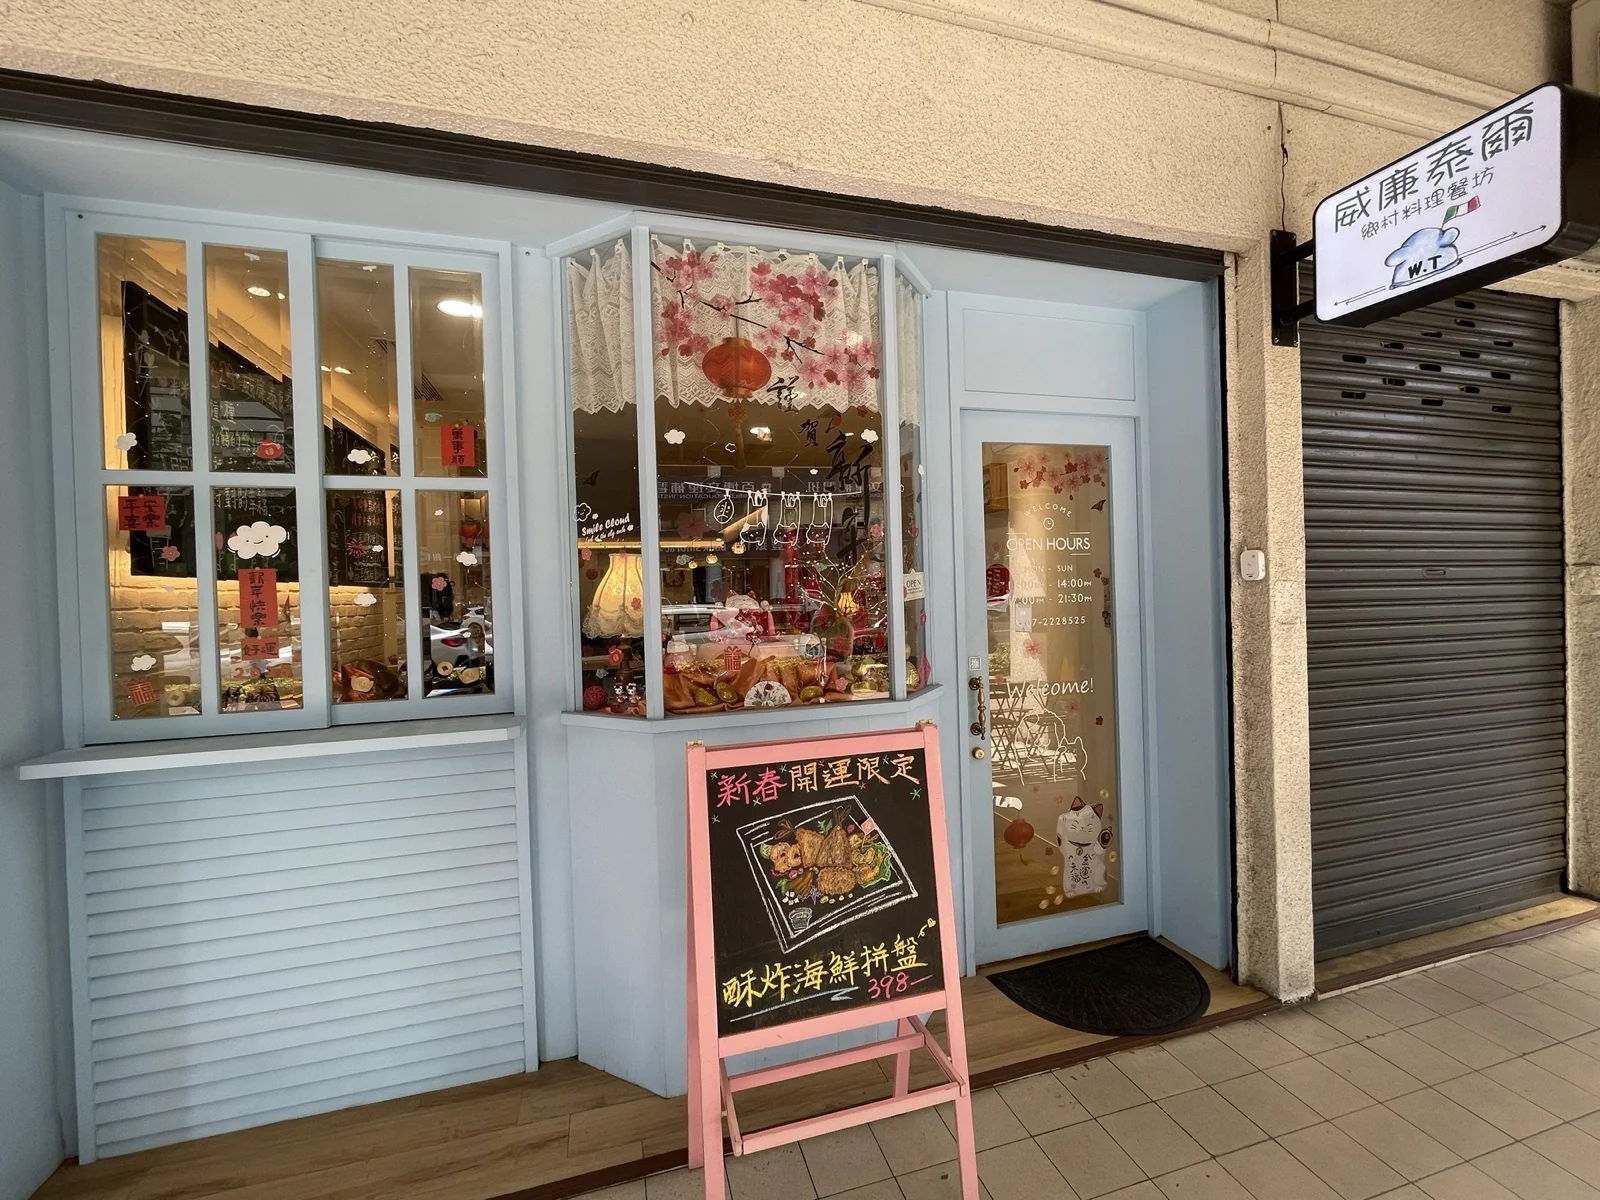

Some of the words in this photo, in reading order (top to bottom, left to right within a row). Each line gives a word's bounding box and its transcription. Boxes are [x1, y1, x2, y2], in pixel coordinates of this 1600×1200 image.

[1335, 102, 1534, 233] 威廉泰爾
[123, 499, 160, 513] 平安
[1024, 502, 1072, 518] WELCOME
[123, 515, 160, 529] 喜樂
[582, 522, 603, 536] Smile
[605, 513, 630, 529] Cloud
[1006, 537, 1043, 551] OPEN
[1046, 537, 1091, 551] HOURS
[1056, 564, 1073, 573] SUN
[906, 579, 921, 589] OPEN
[1057, 578, 1092, 589] 14:00PM
[1058, 593, 1093, 604] 21:30PM
[242, 642, 278, 656] 好運
[1006, 677, 1094, 699] Welcome!
[716, 753, 920, 808] 新春開運限定
[722, 933, 928, 1008] 酥炸海鮮拼盤
